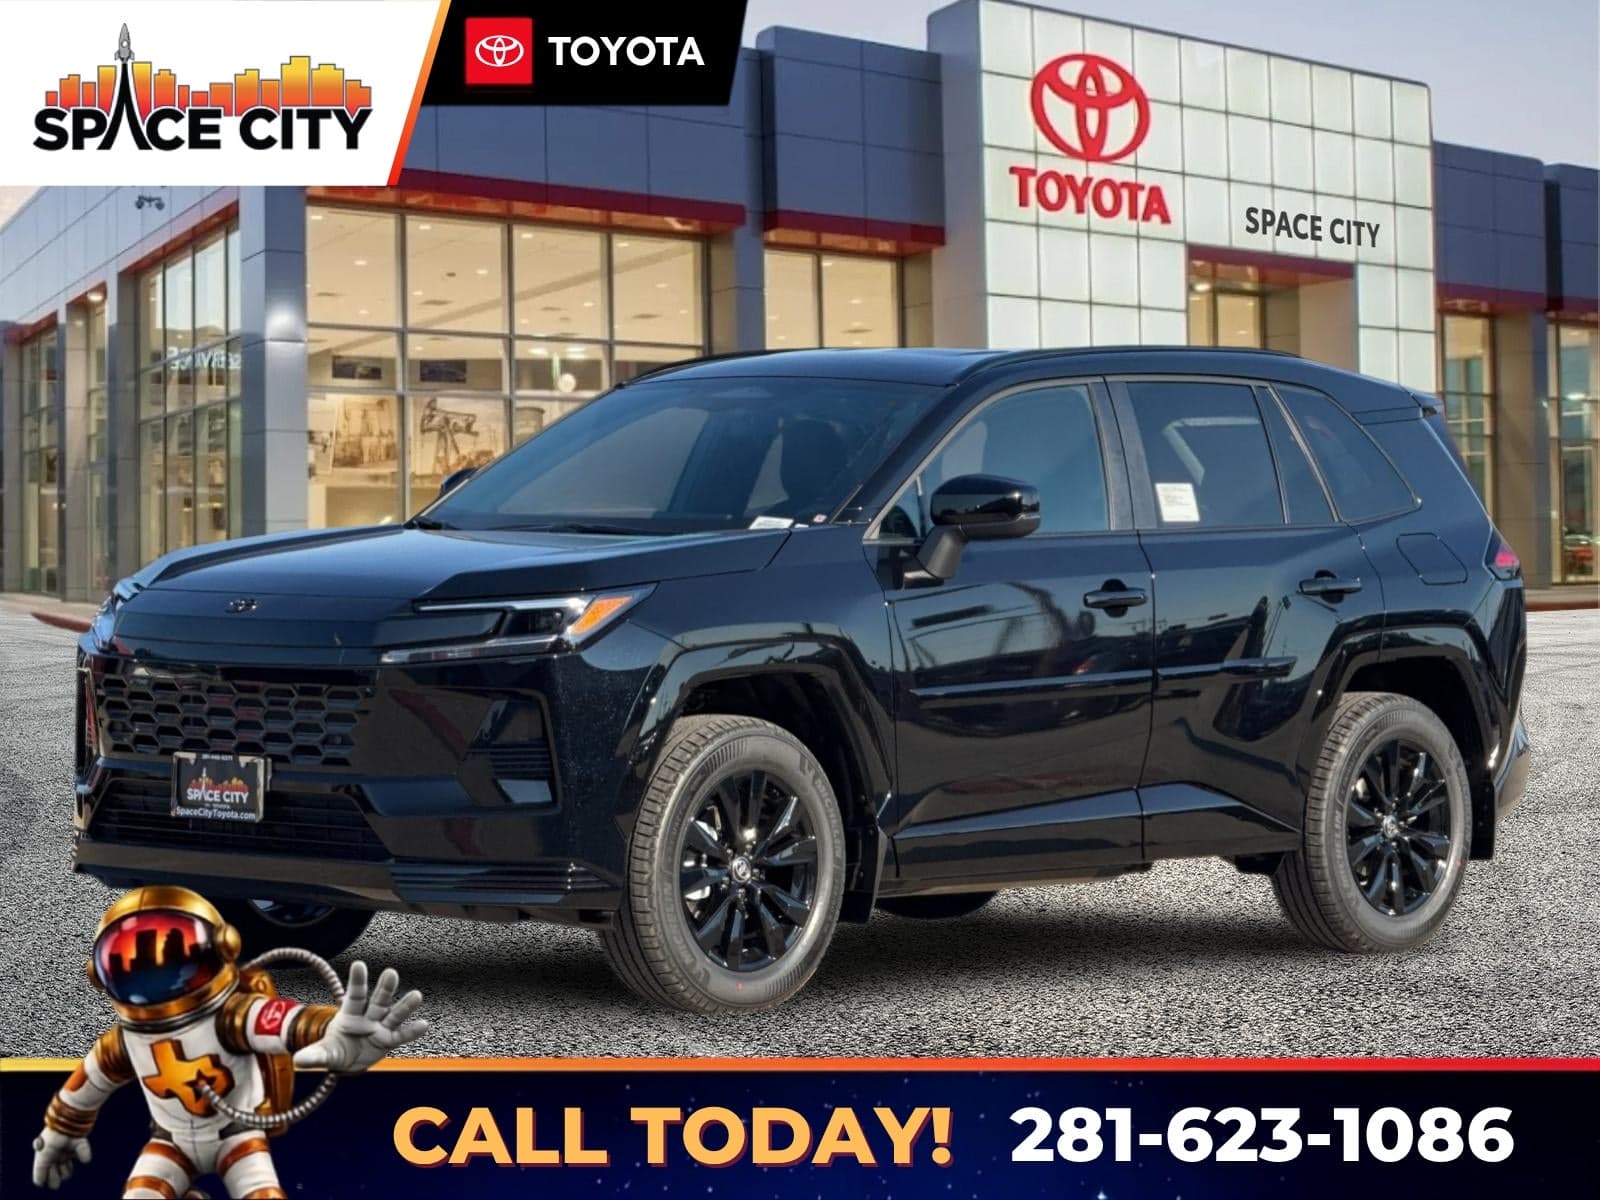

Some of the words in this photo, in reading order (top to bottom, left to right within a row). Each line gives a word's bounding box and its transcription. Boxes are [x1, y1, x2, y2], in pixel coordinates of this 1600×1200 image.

[1009, 165, 1171, 224] TOYOTA
[1245, 206, 1323, 242] SPACE
[1329, 218, 1380, 248] CITY
[187, 788, 220, 802] SPACE
[223, 791, 249, 804] CITY
[176, 806, 256, 820] SpaceCityToyota.com
